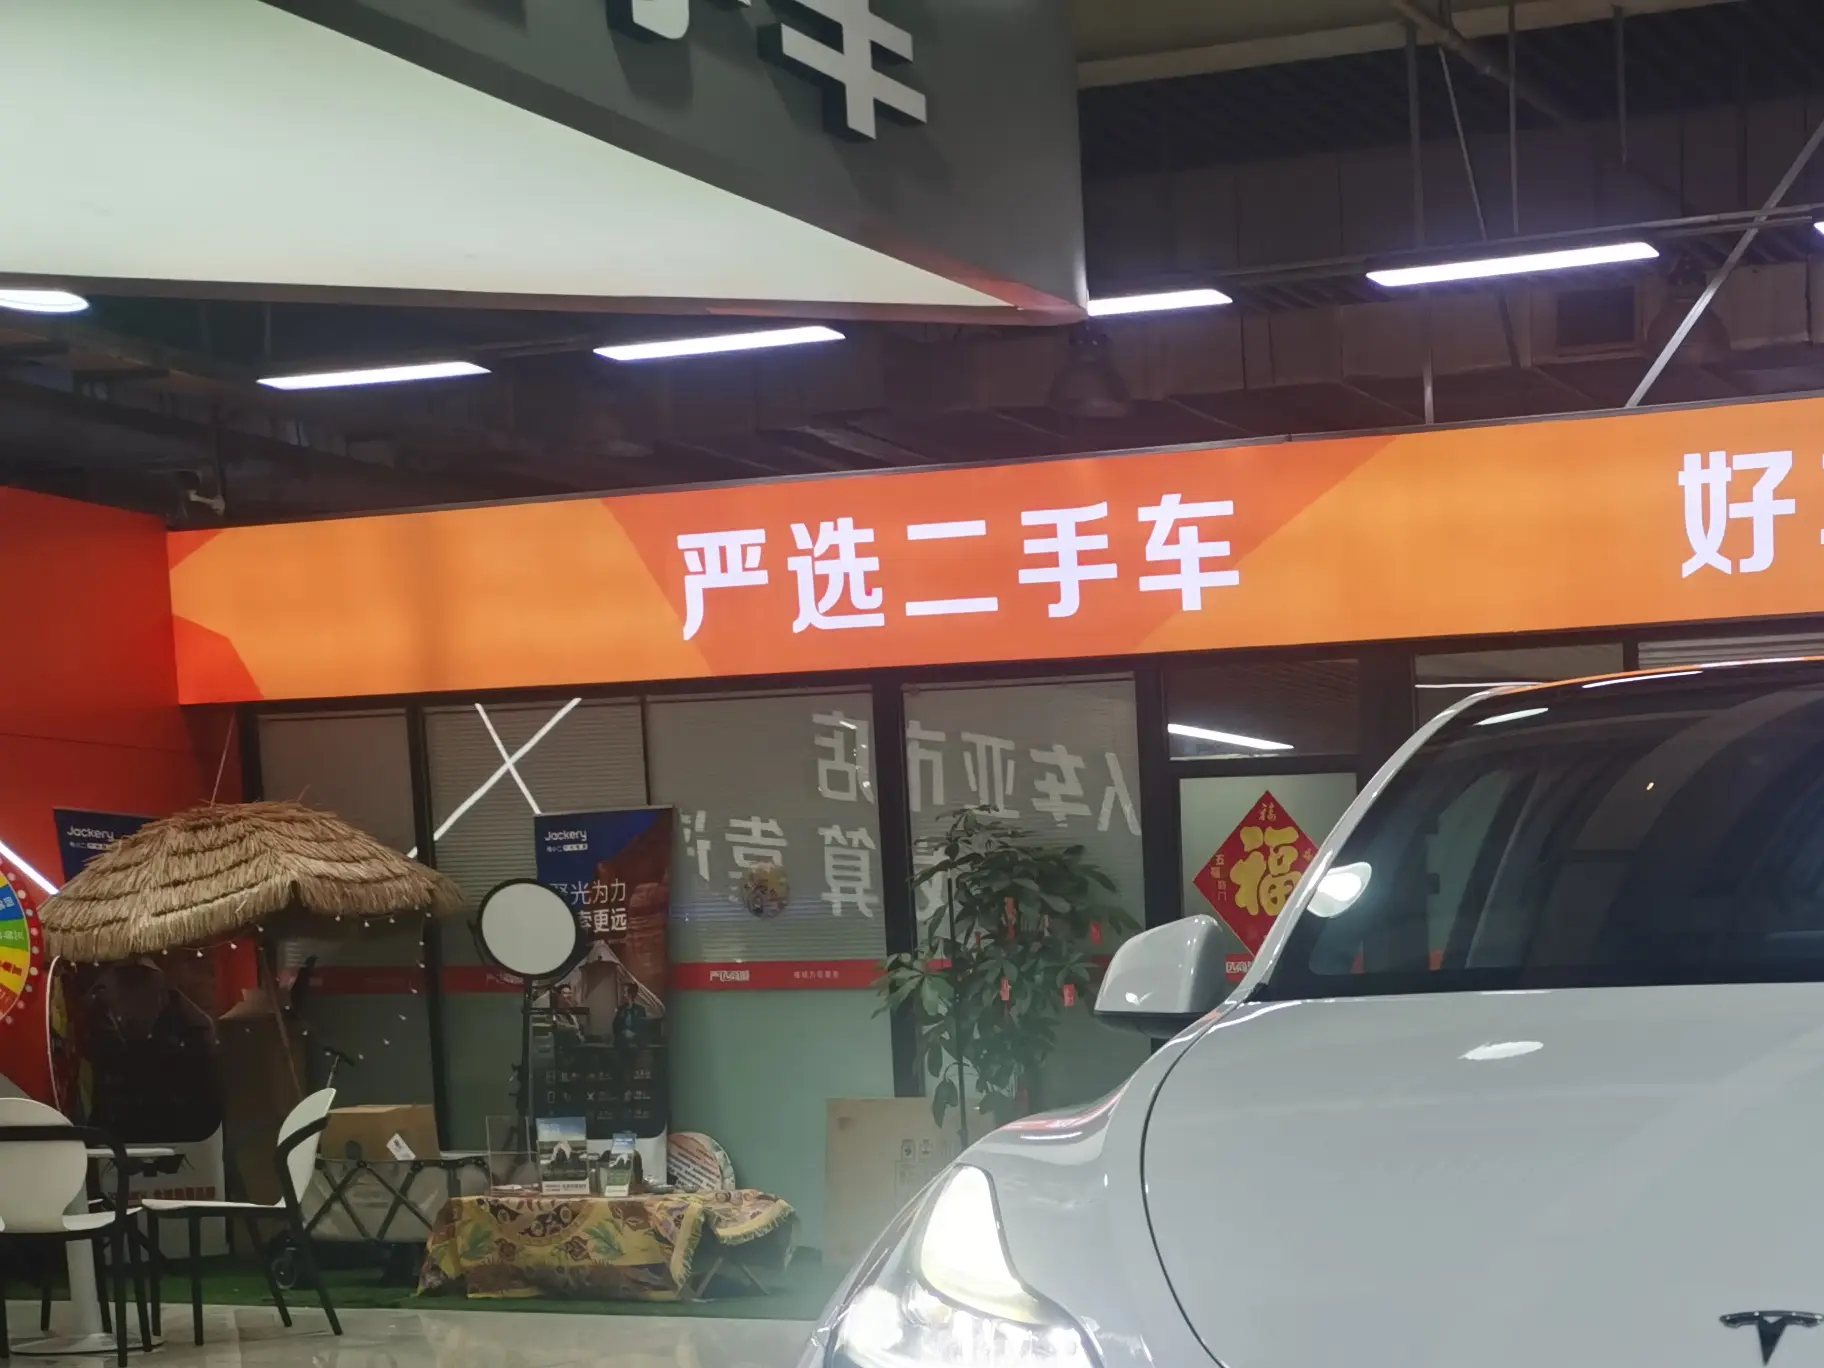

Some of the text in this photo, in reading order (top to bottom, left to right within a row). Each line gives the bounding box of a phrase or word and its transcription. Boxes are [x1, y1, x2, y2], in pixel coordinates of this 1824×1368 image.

[677, 493, 1239, 640] 严选二手车
[66, 825, 115, 842] Jackery
[544, 830, 588, 842] Jackery
[1230, 826, 1303, 917] 福
